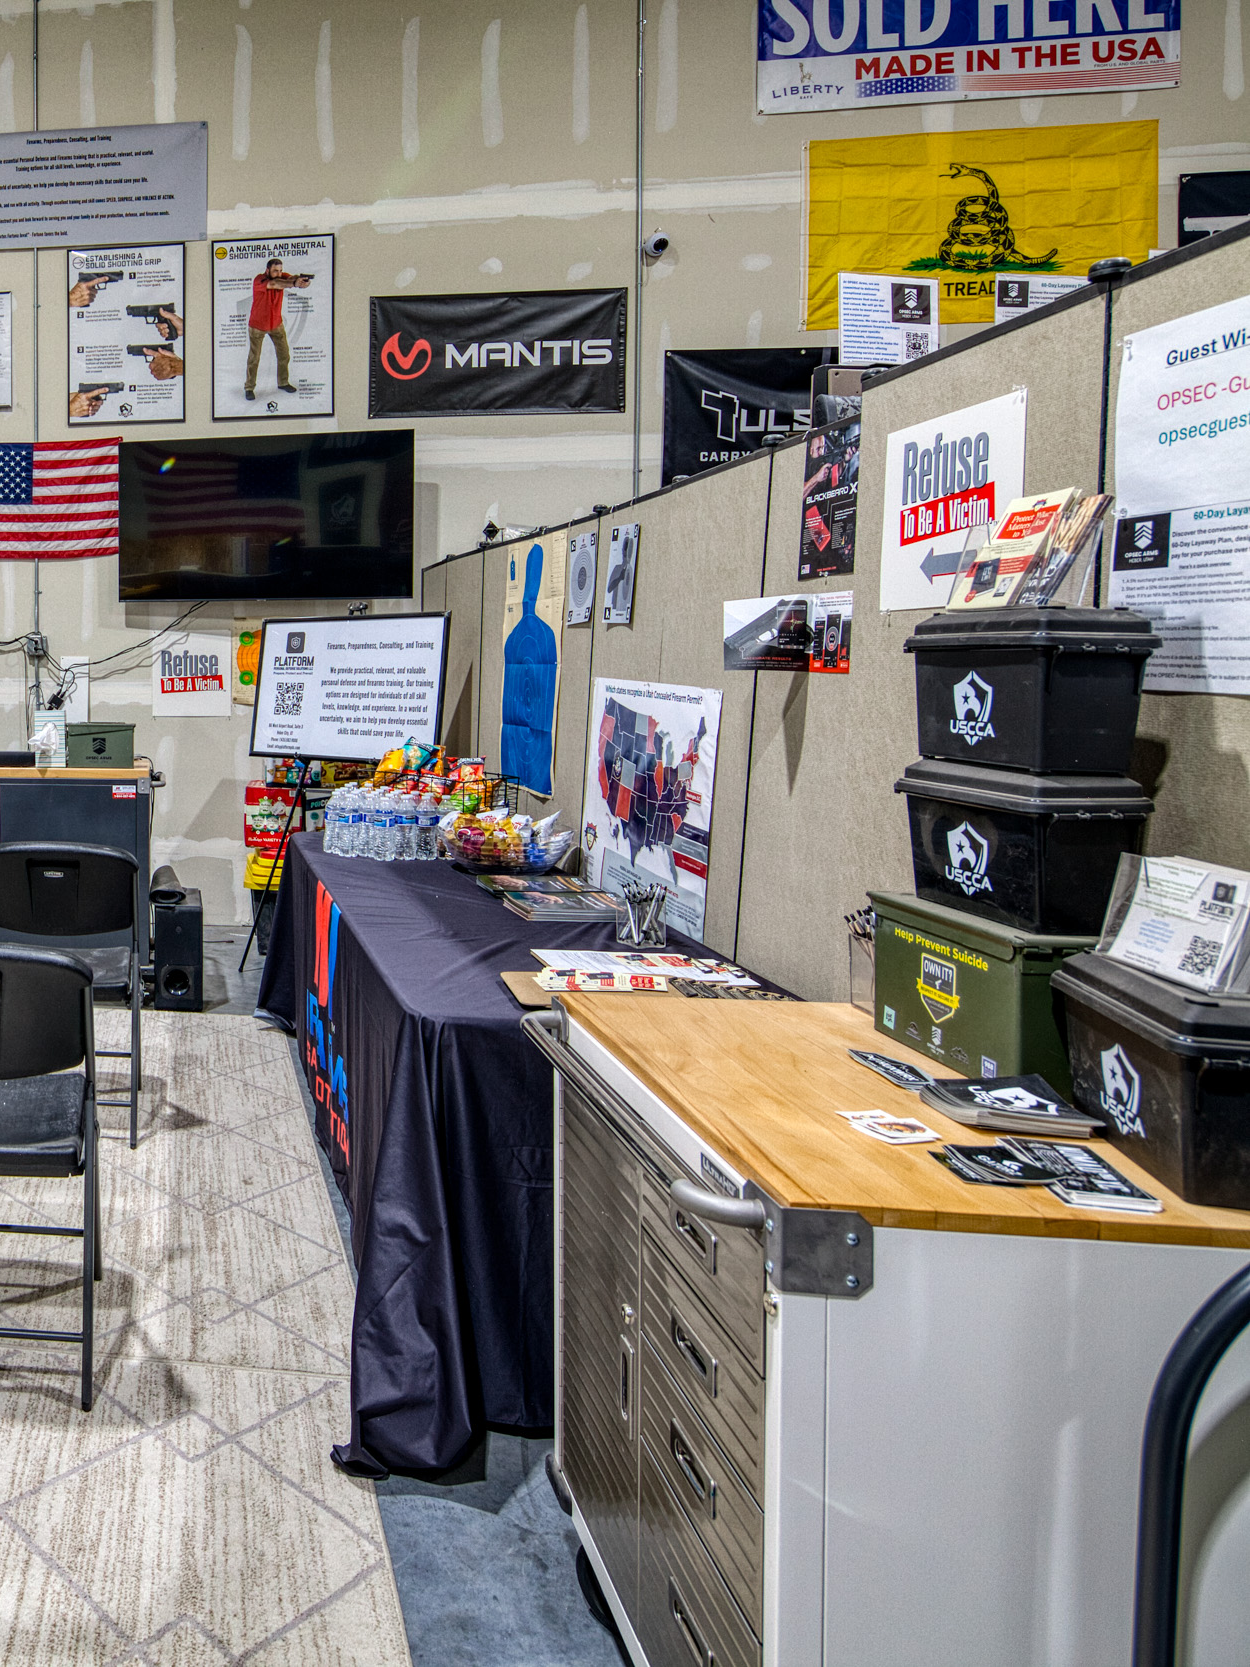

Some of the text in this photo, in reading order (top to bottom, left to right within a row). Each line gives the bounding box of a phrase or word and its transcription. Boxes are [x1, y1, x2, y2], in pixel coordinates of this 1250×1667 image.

[855, 37, 1165, 81] MADE IN THE USA
[772, 84, 844, 99] LIBERTY
[290, 241, 326, 249] NEUTRAL
[86, 253, 136, 262] ESTABLISHING
[229, 250, 308, 260] SHOOTING PLATFORM
[445, 339, 613, 368] MANTIS
[1166, 339, 1218, 366] Guest
[902, 432, 990, 505] Refuse
[806, 482, 858, 505] BLACKBEARD X
[903, 509, 915, 539] To
[917, 506, 933, 536] Be
[936, 503, 945, 533] A
[949, 495, 993, 529] Victim.
[1194, 510, 1225, 520] 60-Day
[1172, 529, 1196, 537] Discover
[1208, 525, 1248, 533] convenience
[1191, 539, 1217, 547] Layaway
[1204, 549, 1233, 557] purchase
[327, 642, 346, 650] Firearms,
[348, 642, 378, 650] Preparedness,
[379, 642, 404, 650] Consulting,
[416, 641, 434, 650] Training
[161, 650, 218, 676] Refuse
[274, 656, 314, 666] PLATFORM
[337, 667, 353, 675] provide
[354, 667, 374, 675] practical,
[163, 678, 222, 691] To Be A Victim.
[321, 679, 339, 687] personal
[386, 680, 405, 688] training.
[416, 680, 434, 688] training
[384, 730, 394, 738] your
[950, 719, 995, 738] USCCA
[945, 865, 993, 893] USCCA
[894, 927, 989, 972] Help Prevent Suicide
[924, 960, 953, 982] OWN IT?
[1099, 1090, 1146, 1139] USCCA
